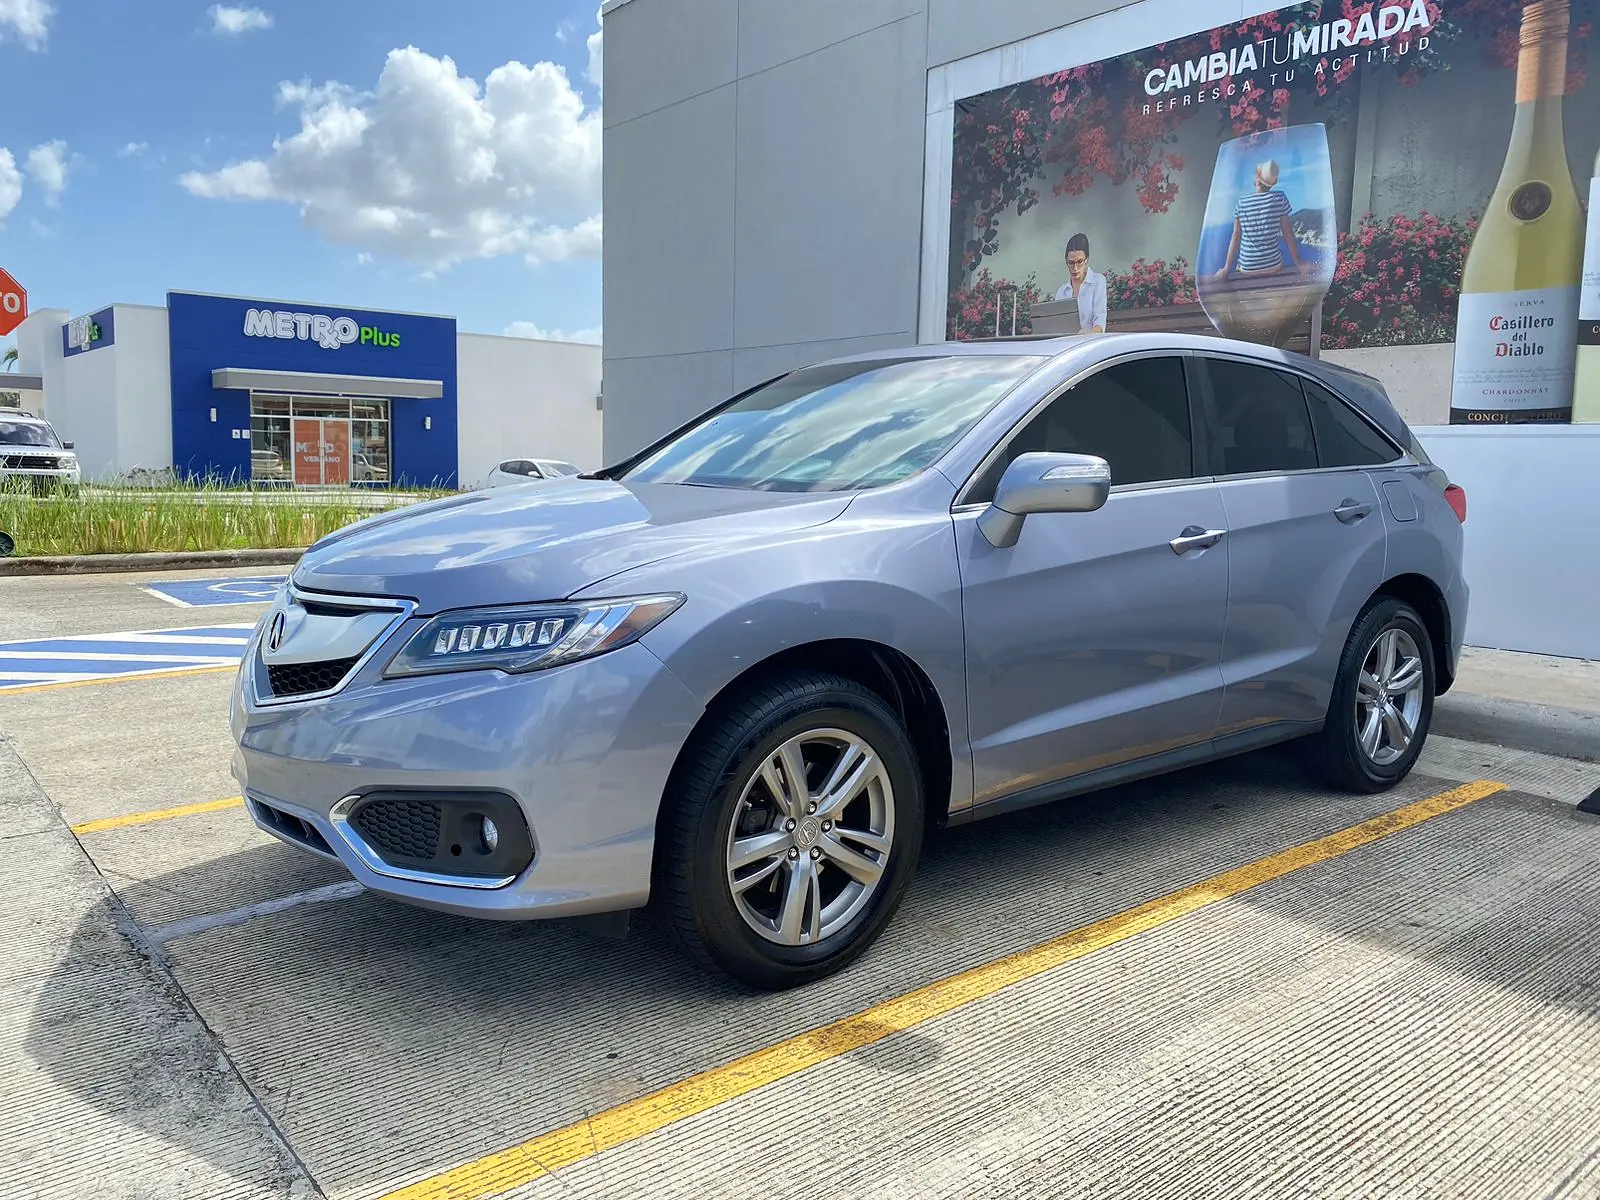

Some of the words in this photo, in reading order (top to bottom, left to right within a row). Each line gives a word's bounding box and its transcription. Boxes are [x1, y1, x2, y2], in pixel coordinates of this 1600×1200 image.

[1142, 80, 1252, 116] REFRESCA
[1270, 69, 1295, 86] TU
[1313, 37, 1430, 76] ACTITUD
[243, 308, 359, 350] METRO
[360, 327, 400, 347] Plus
[1489, 315, 1554, 331] Casillero
[1512, 332, 1527, 341] del
[1495, 342, 1544, 357] Diablo
[1482, 387, 1550, 396] CHARDONNAY
